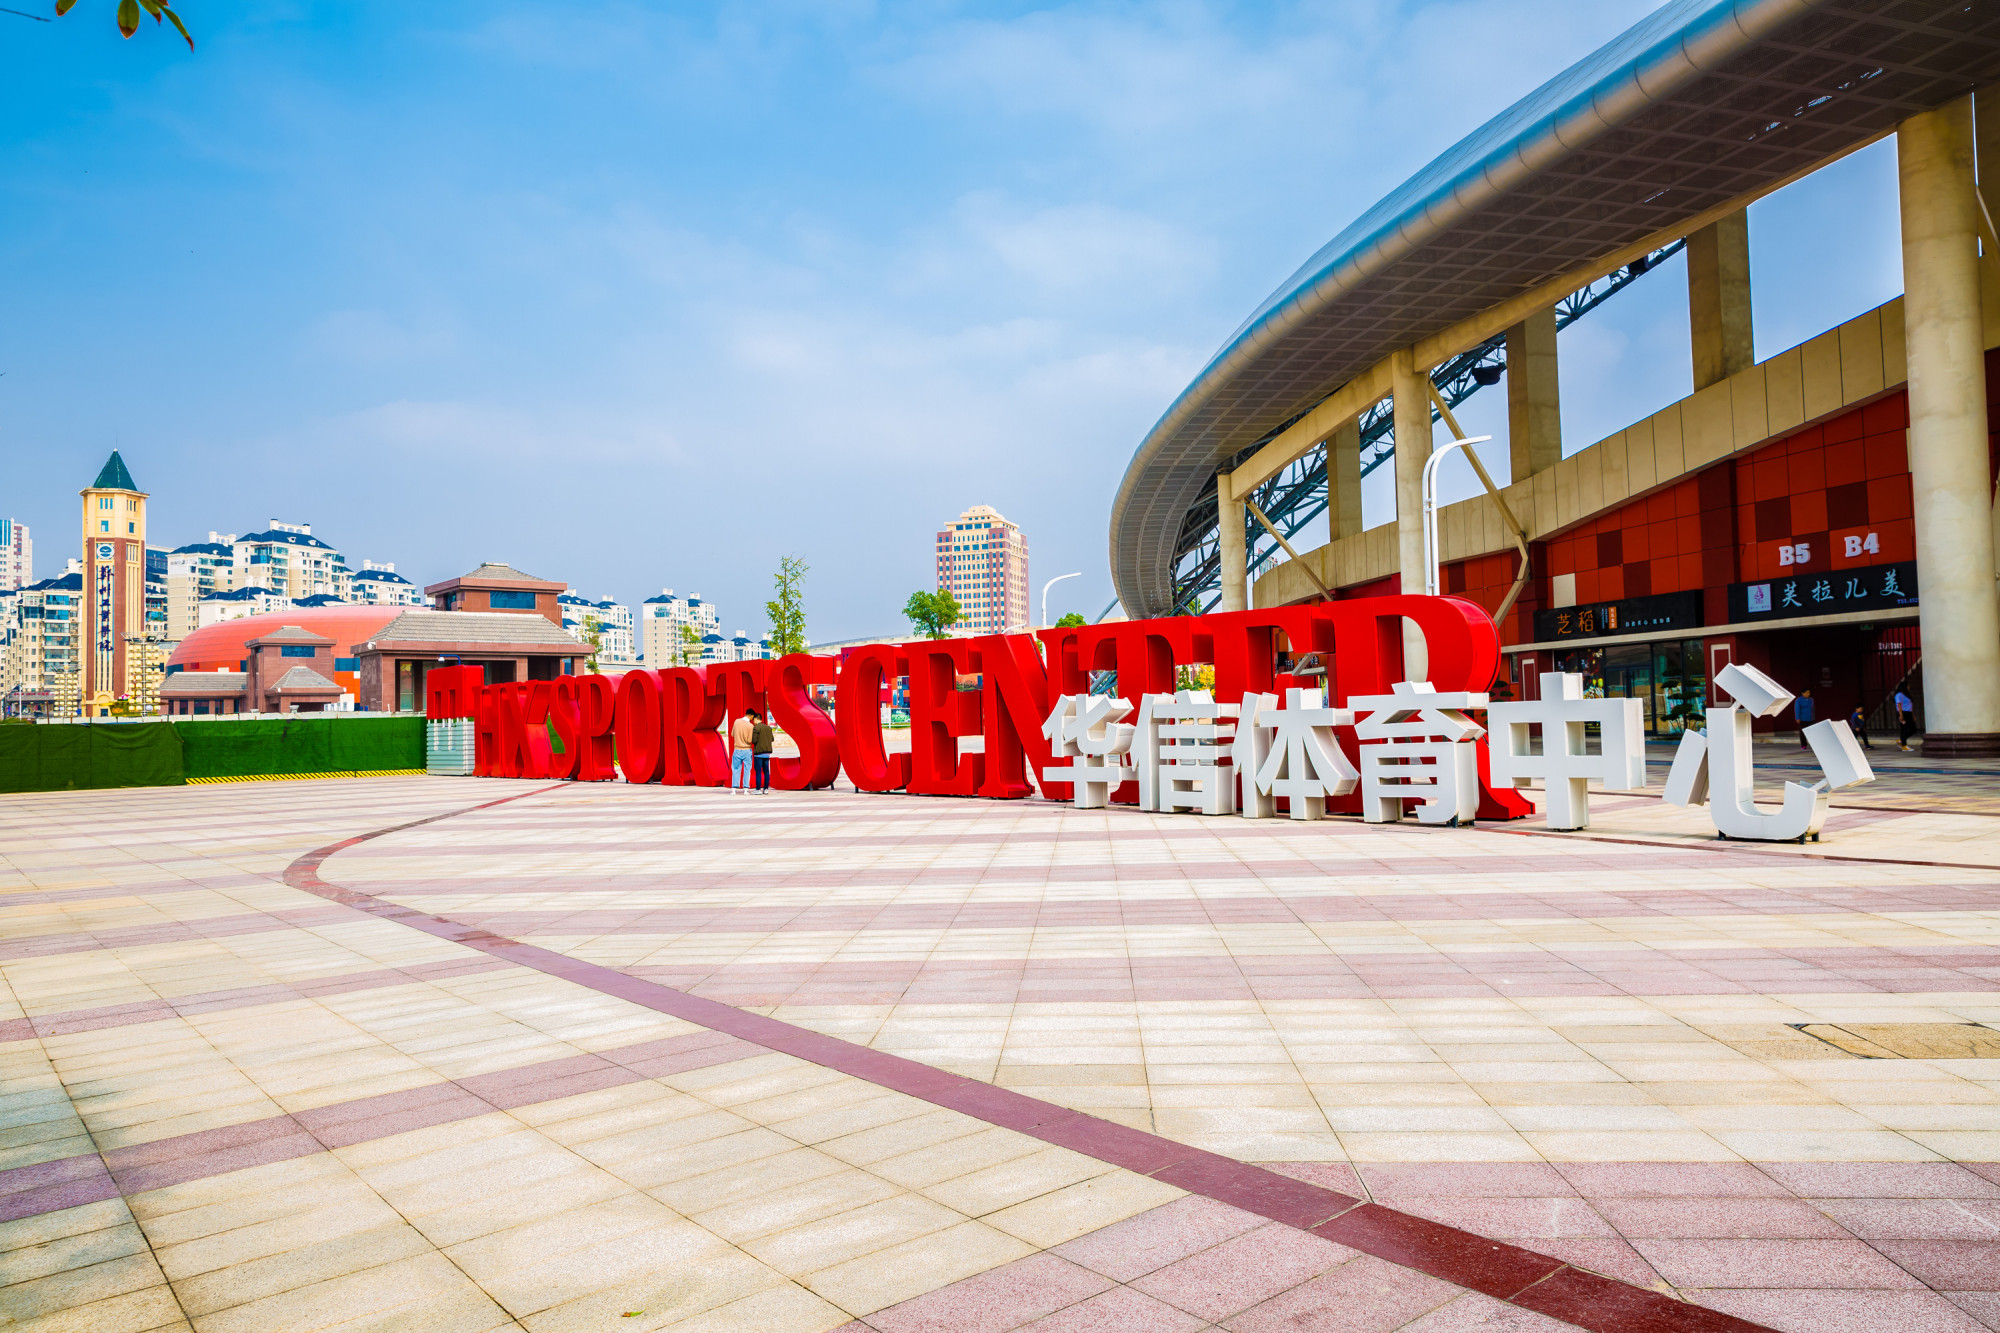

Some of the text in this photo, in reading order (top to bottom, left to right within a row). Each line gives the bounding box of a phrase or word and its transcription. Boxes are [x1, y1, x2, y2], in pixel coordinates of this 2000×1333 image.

[1779, 543, 1811, 566] B5
[1844, 532, 1880, 558] B4
[1041, 662, 1876, 842] 华信体育中心
